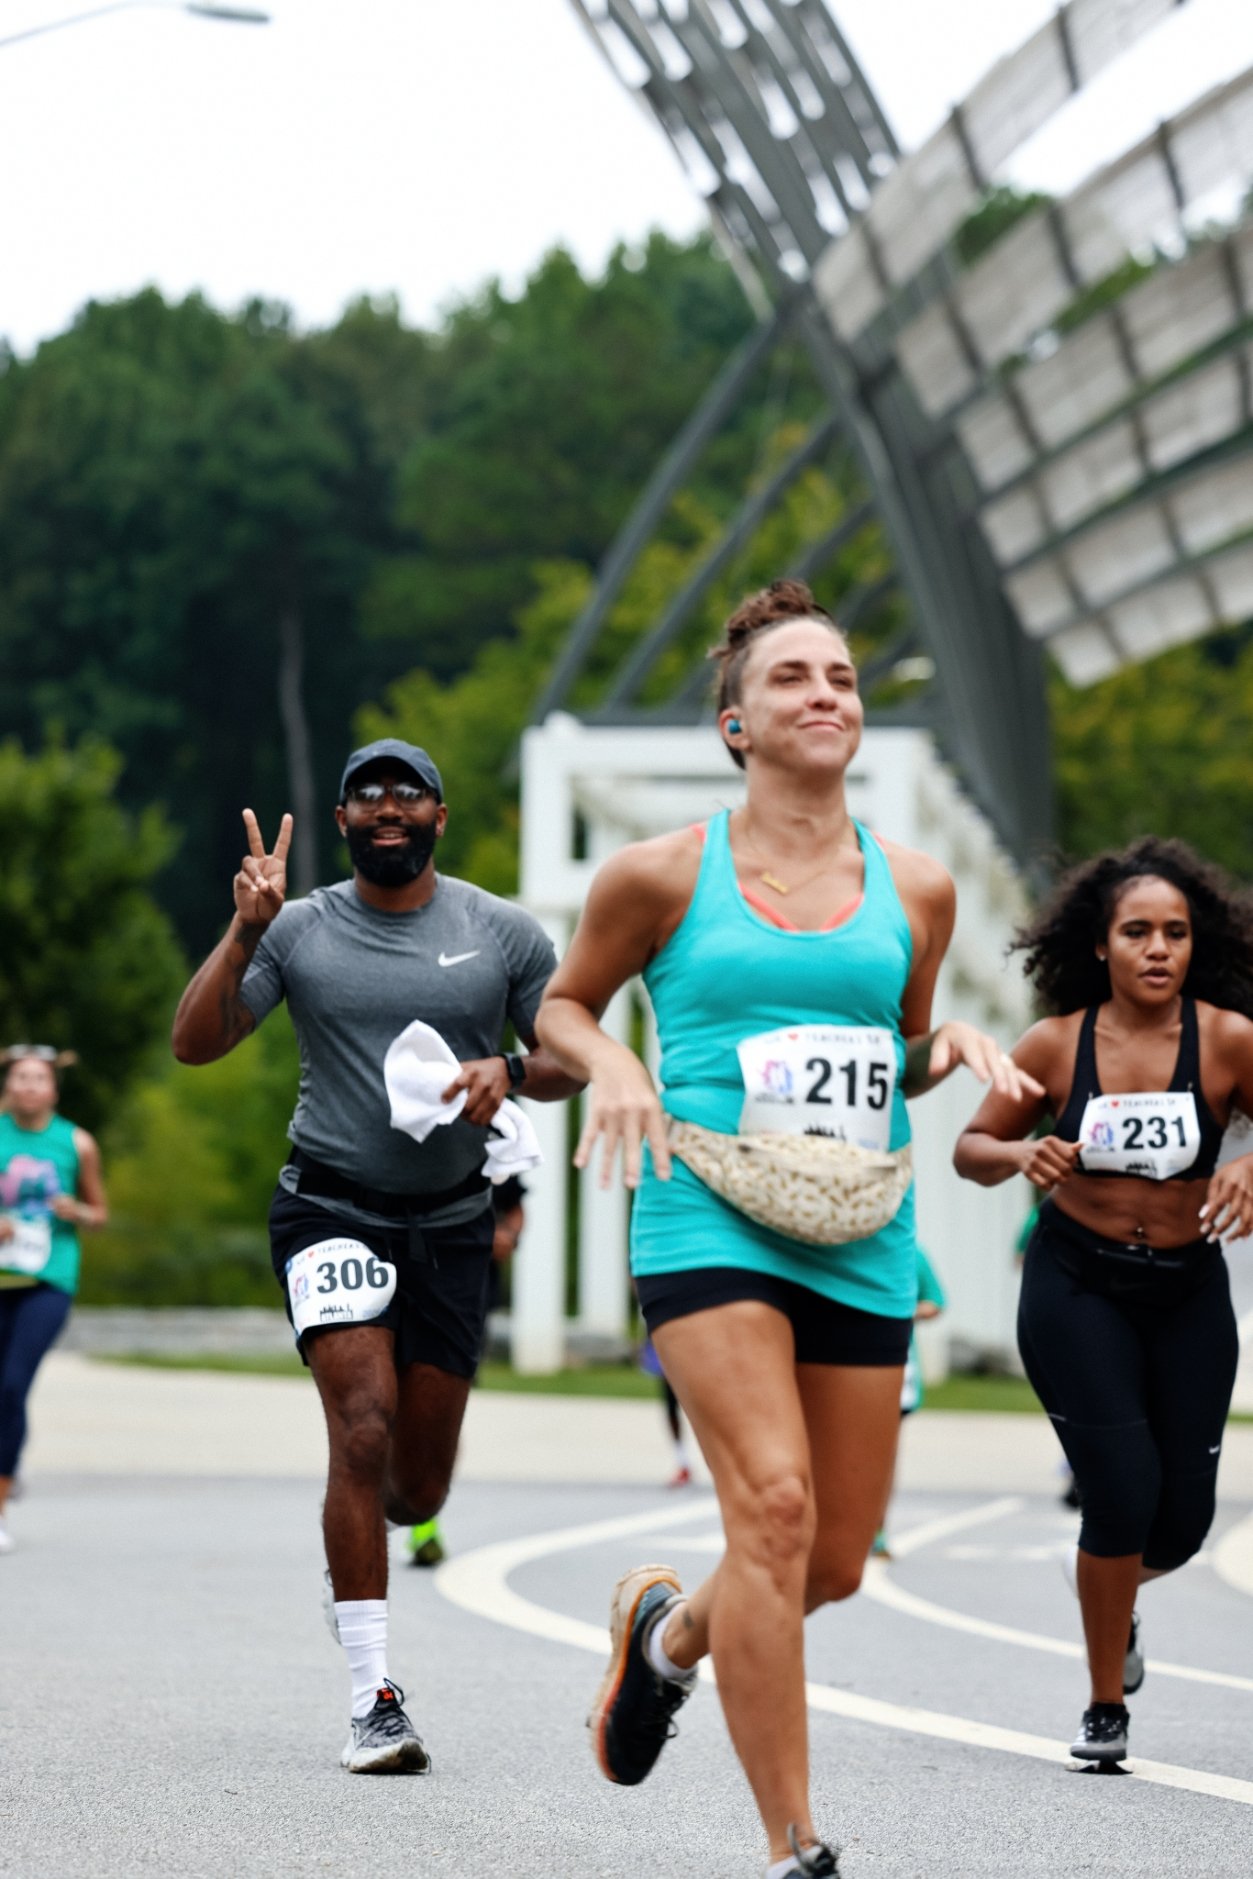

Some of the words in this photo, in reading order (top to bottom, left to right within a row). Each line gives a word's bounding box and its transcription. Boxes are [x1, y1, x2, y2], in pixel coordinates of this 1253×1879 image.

[805, 1057, 888, 1111] 215
[1122, 1116, 1187, 1150] 231
[316, 1255, 389, 1294] 306
